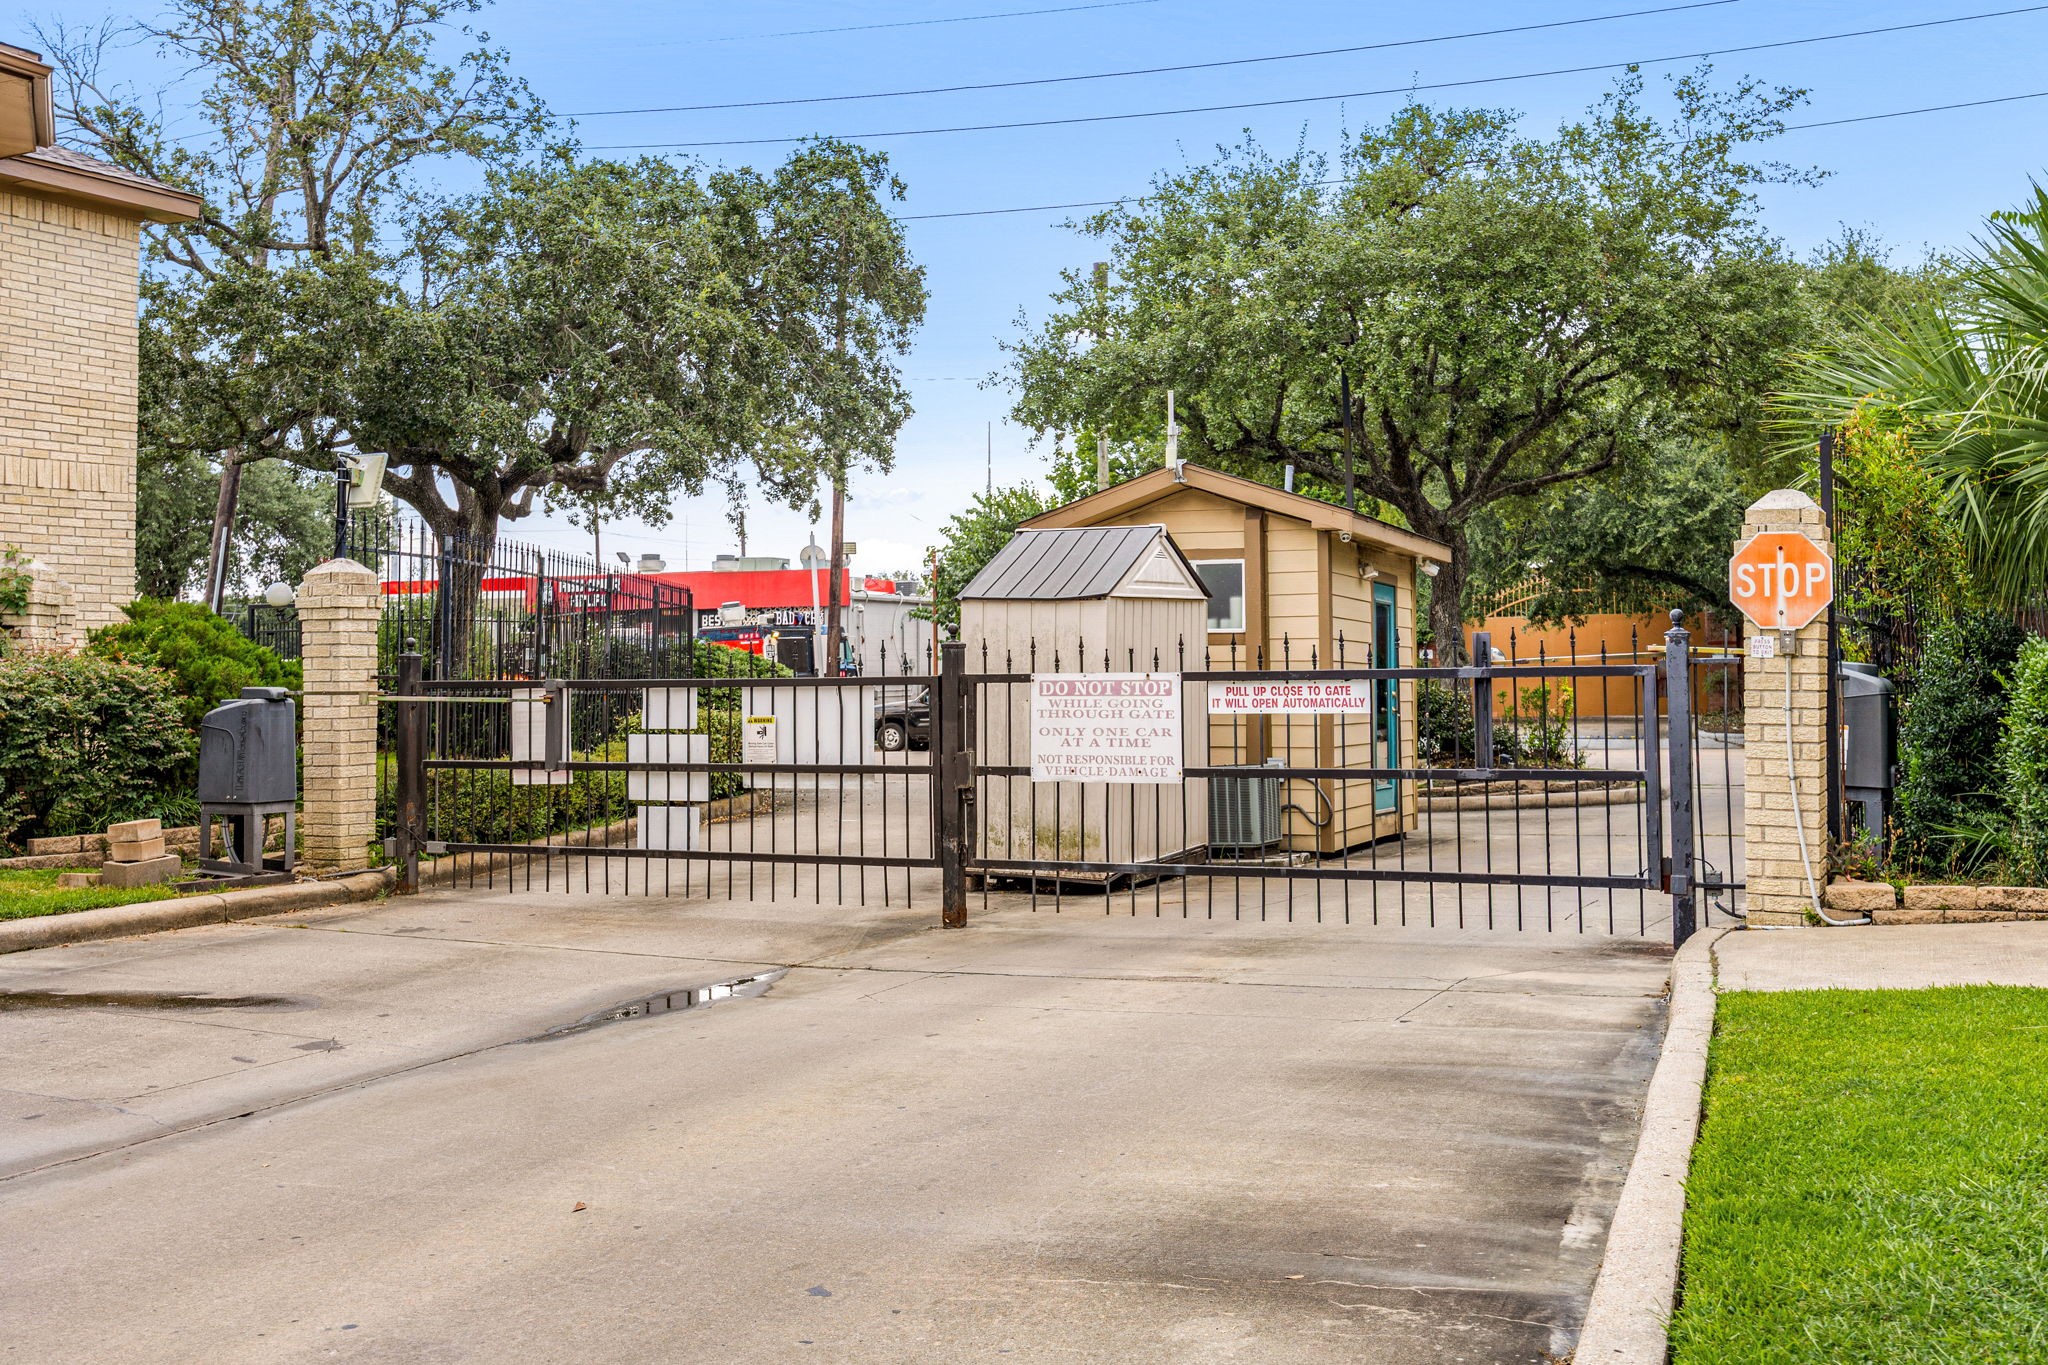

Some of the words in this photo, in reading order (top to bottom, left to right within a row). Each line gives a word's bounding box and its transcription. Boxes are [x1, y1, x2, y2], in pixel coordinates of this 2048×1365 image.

[1736, 562, 1826, 598] STOP
[775, 611, 795, 626] BAD
[1041, 681, 1069, 696] DO
[1074, 681, 1115, 696] NOT
[1120, 681, 1171, 696] STOP
[1225, 686, 1249, 697] PULL
[1253, 686, 1267, 697] UP
[1270, 685, 1303, 697] CLOSE
[1307, 685, 1321, 696] TO
[1325, 685, 1352, 696] GATE
[1048, 699, 1103, 709] WHILE
[1107, 699, 1164, 709] GOING
[1212, 698, 1221, 709] IT
[1225, 698, 1248, 709] WILL
[1252, 698, 1279, 708] OPEN
[1283, 697, 1366, 708] AUTOMATICALLY
[1037, 709, 1123, 719] THROUGH
[1129, 709, 1175, 720] GATE
[1039, 727, 1086, 737] ONLY
[1092, 727, 1129, 737] ONE
[1135, 727, 1173, 737] CAR
[1060, 738, 1084, 748] AT
[1089, 738, 1100, 748] A
[1106, 738, 1152, 748] TIME
[1038, 754, 1063, 765] NOT
[1066, 754, 1147, 766] RESPONSIBLE
[1150, 755, 1175, 766] FOR
[1045, 766, 1104, 776] VEHICLE
[1108, 767, 1168, 777] DAMAGE
